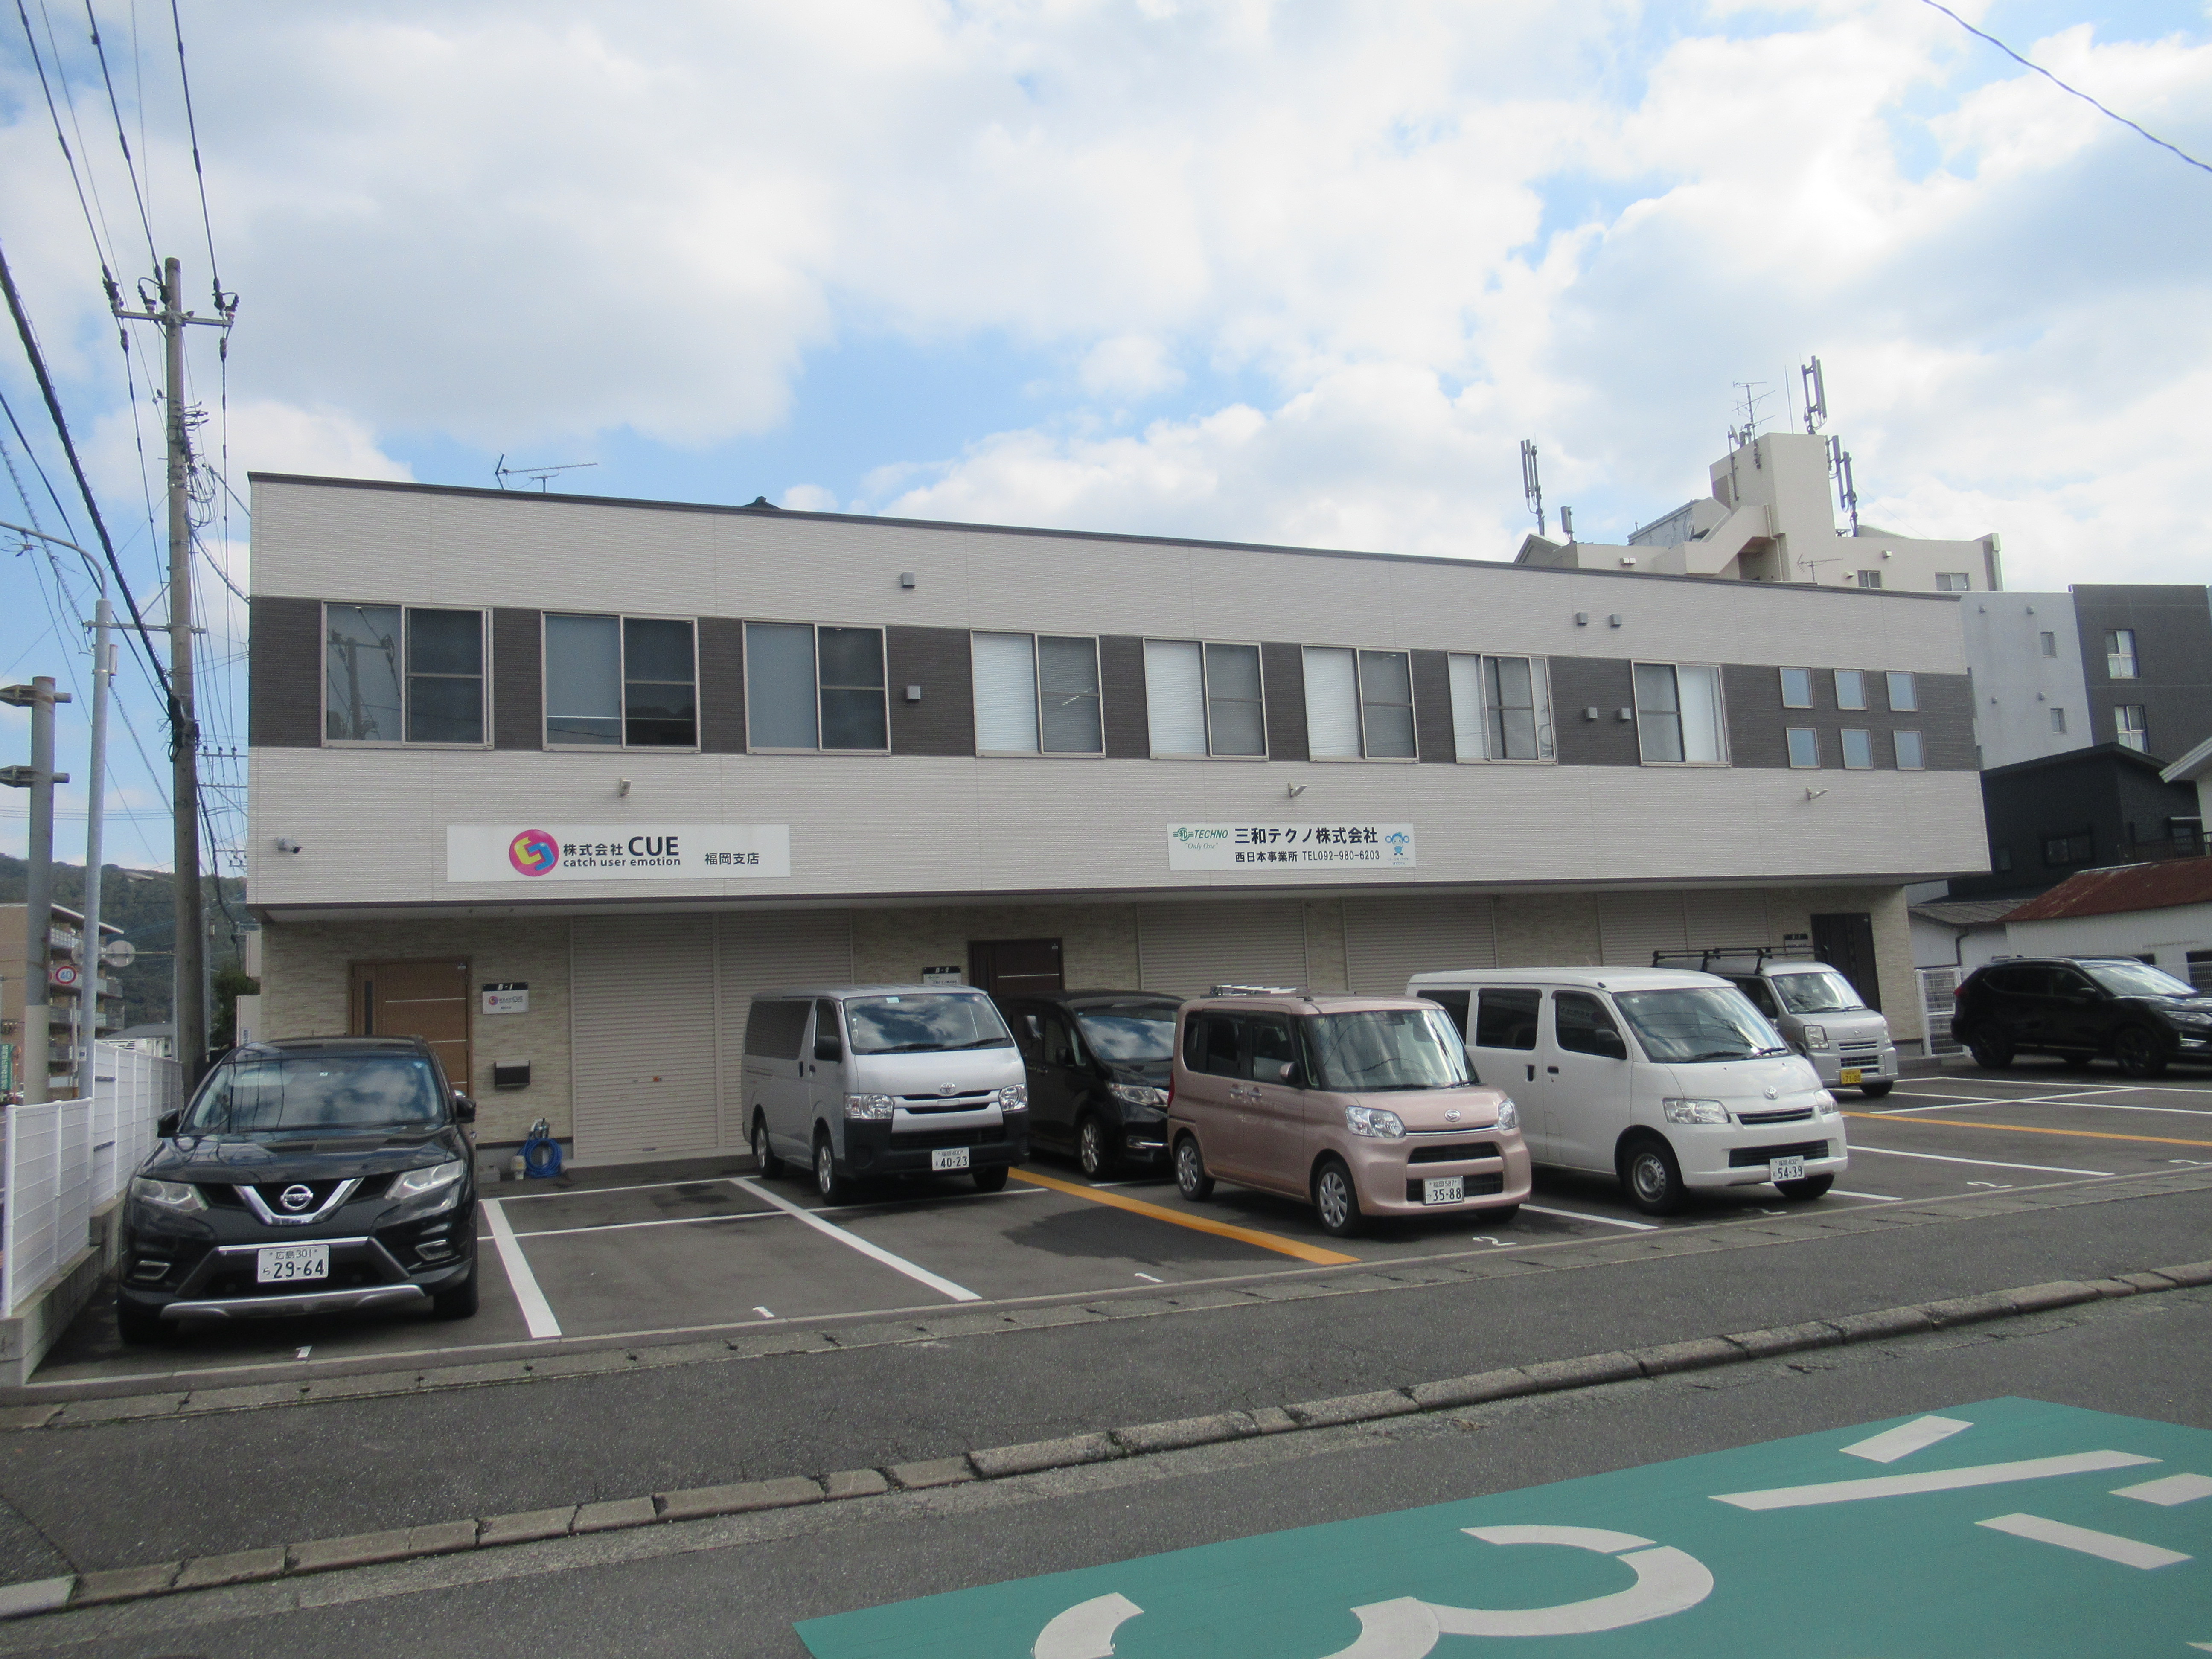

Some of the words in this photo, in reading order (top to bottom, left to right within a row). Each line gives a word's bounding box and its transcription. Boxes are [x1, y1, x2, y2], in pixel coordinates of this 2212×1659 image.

[1194, 830, 1228, 838] TECHNO
[1235, 827, 1379, 844] 三和テクノ株式会社
[563, 843, 623, 856] 株式会社
[628, 836, 679, 856] CUE
[563, 858, 596, 867] catch
[600, 859, 626, 867] user
[630, 857, 681, 866] emotion
[705, 853, 760, 865] 福岡支店
[1235, 851, 1298, 863] 西日本事業所
[1302, 850, 1380, 861] TEL092-980-6203
[941, 1156, 967, 1167] 40-23
[1778, 1166, 1802, 1179] 54-39
[1433, 1188, 1461, 1201] 35-88
[1471, 1236, 1517, 1246] 2
[274, 1259, 324, 1278] 29-64
